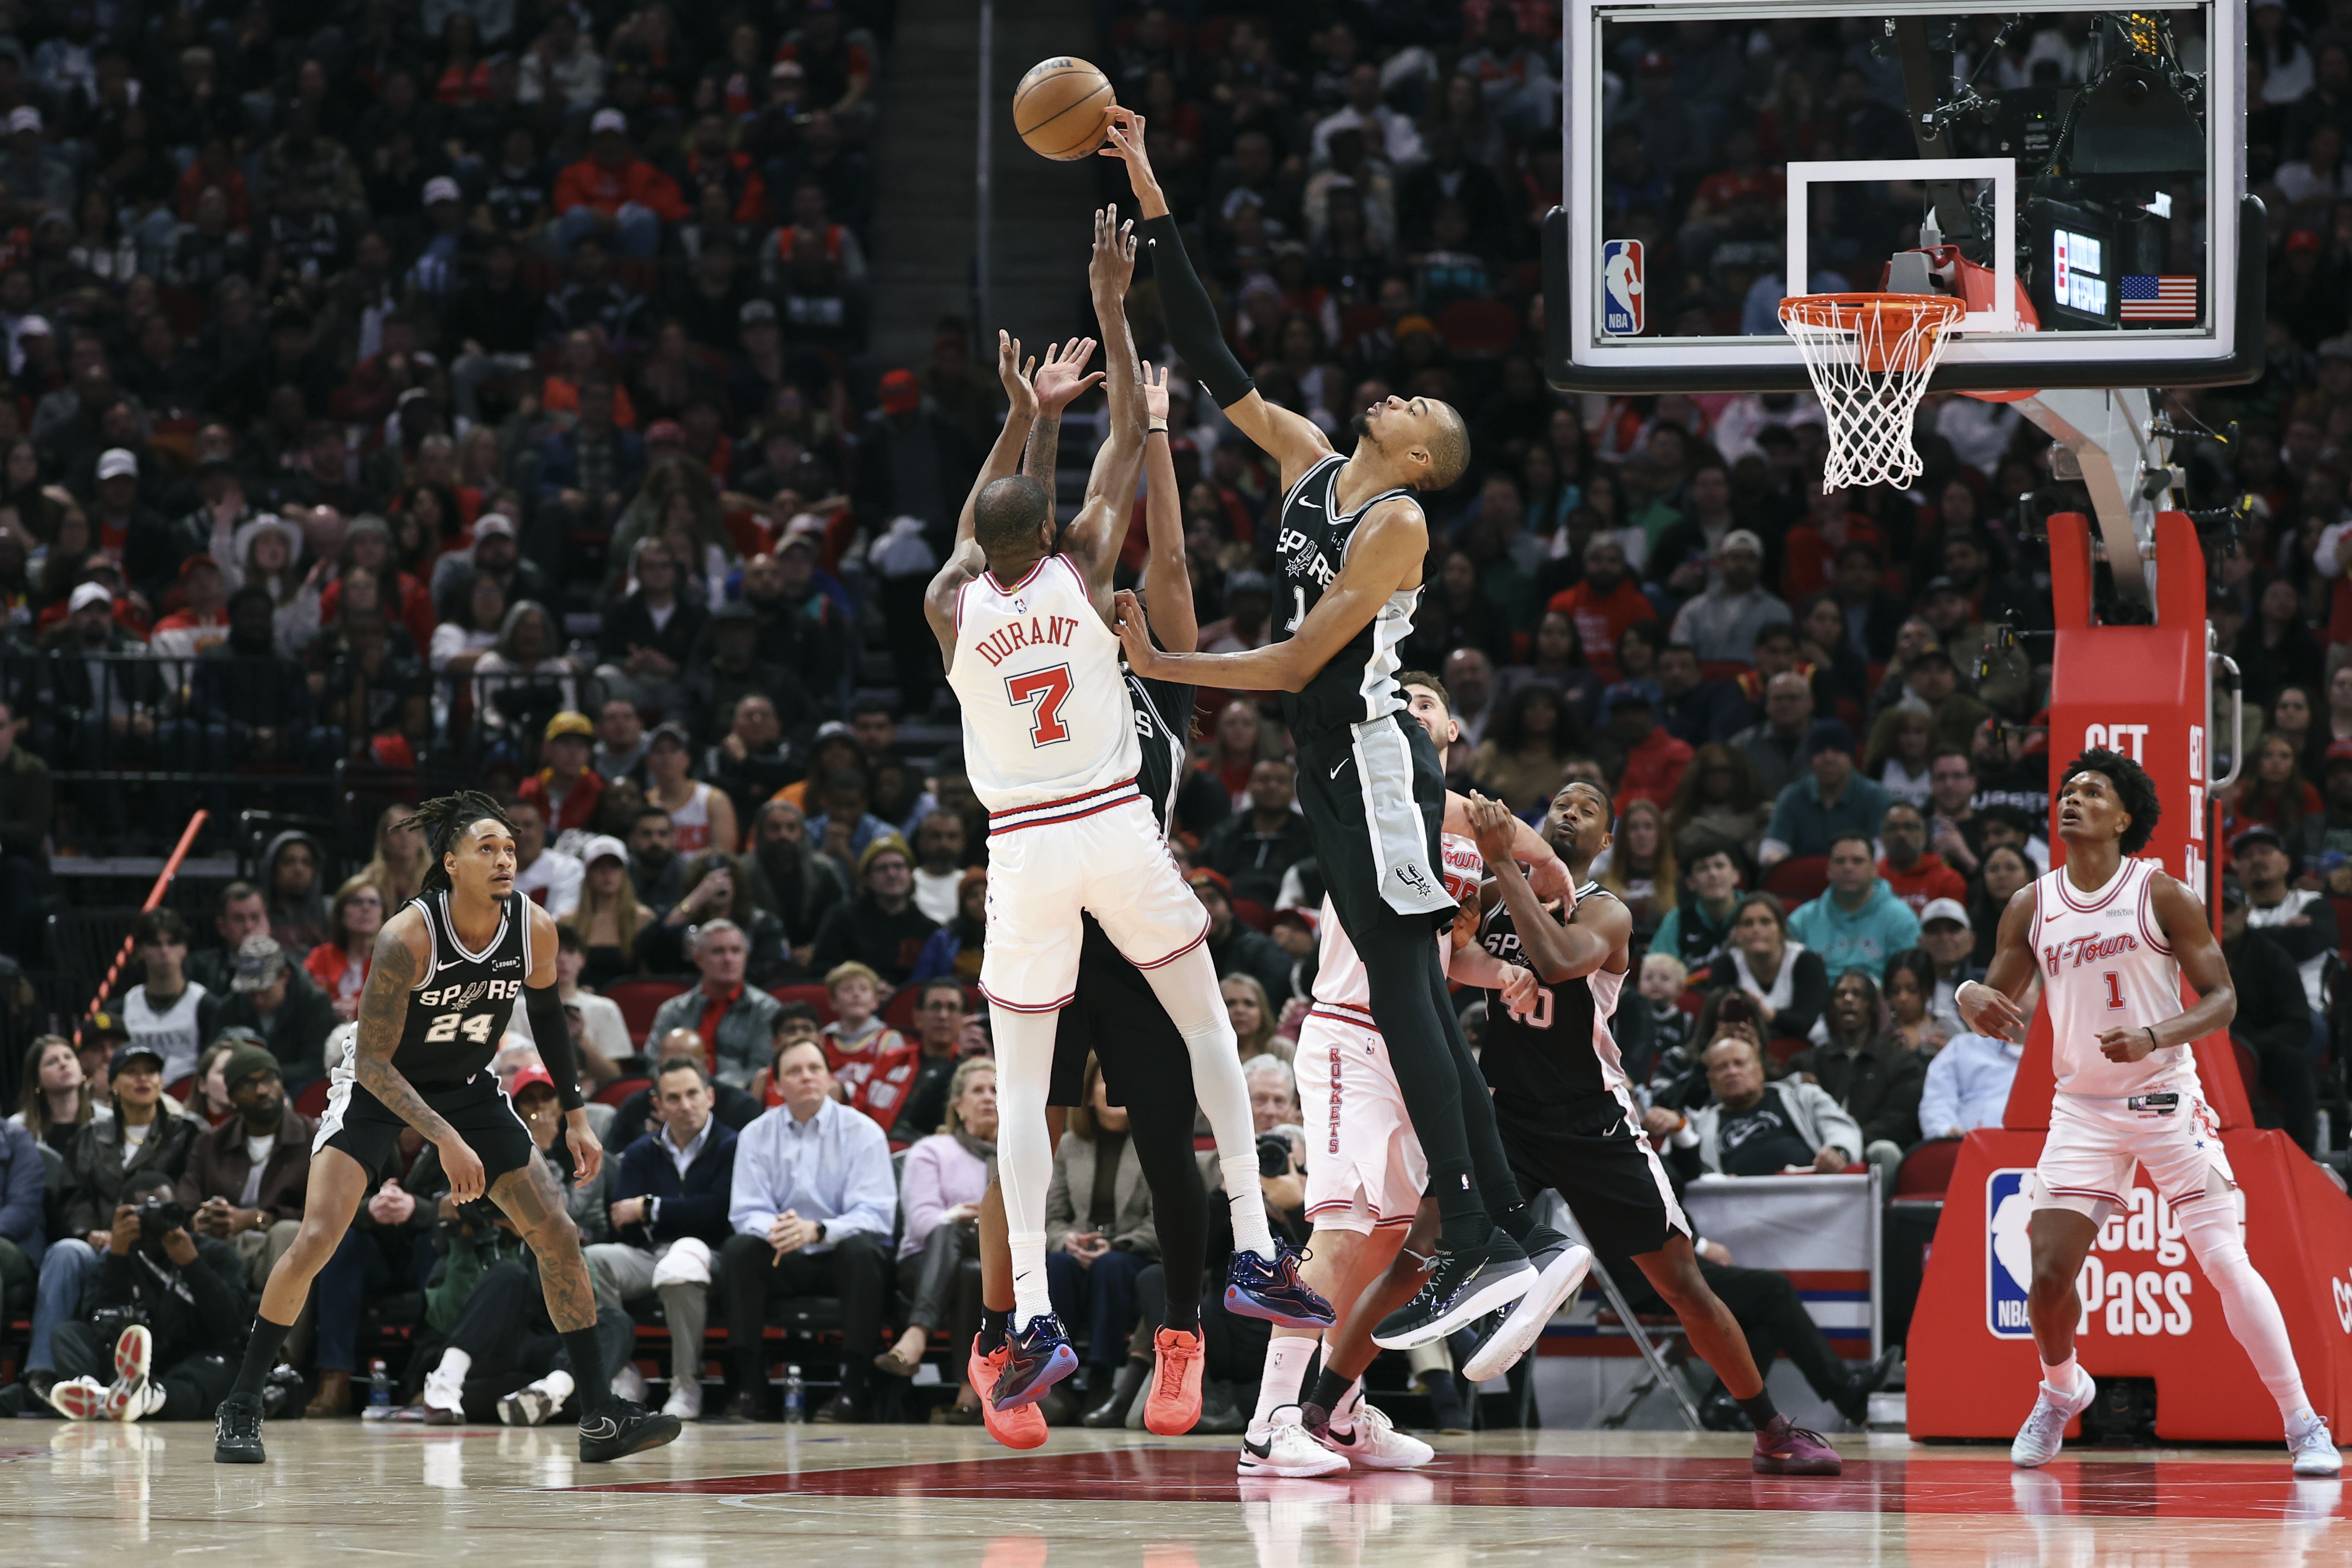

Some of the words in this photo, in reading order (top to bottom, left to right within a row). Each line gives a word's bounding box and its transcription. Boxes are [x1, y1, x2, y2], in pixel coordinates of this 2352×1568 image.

[1608, 313, 1628, 328] NBA
[975, 616, 1079, 667] DURANT
[1003, 662, 1074, 749] 7
[1441, 840, 1484, 873] Town
[2043, 931, 2139, 977] H-Town
[2103, 971, 2126, 1010] 1
[424, 1012, 495, 1045] 24
[1329, 1048, 1344, 1154] ROCKETS
[1998, 1299, 2030, 1328] NBA
[2075, 1255, 2193, 1337] Pass
